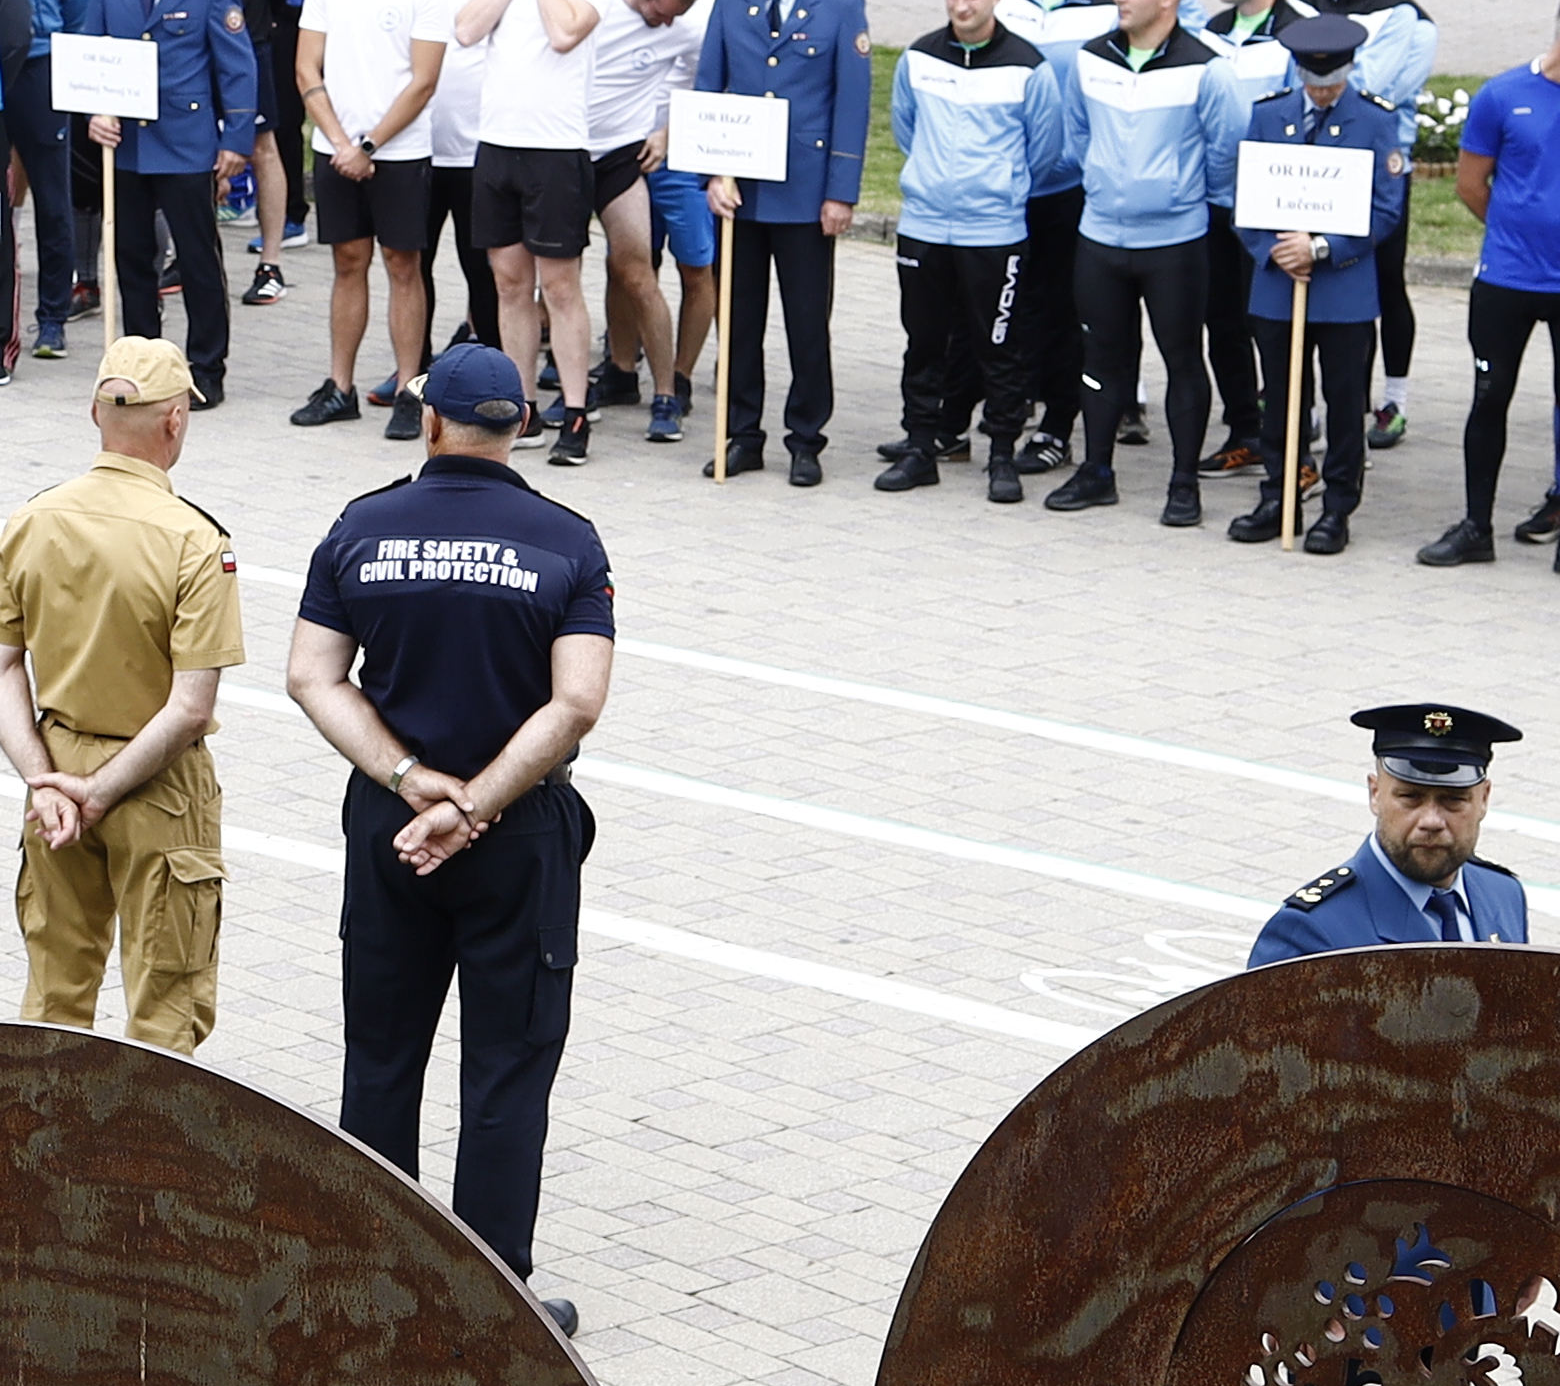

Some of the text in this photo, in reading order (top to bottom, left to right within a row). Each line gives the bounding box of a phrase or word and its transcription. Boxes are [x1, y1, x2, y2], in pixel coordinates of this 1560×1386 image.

[377, 539, 519, 567] FIRE SAFETY &
[359, 561, 538, 593] CIVIL PROTECTION
